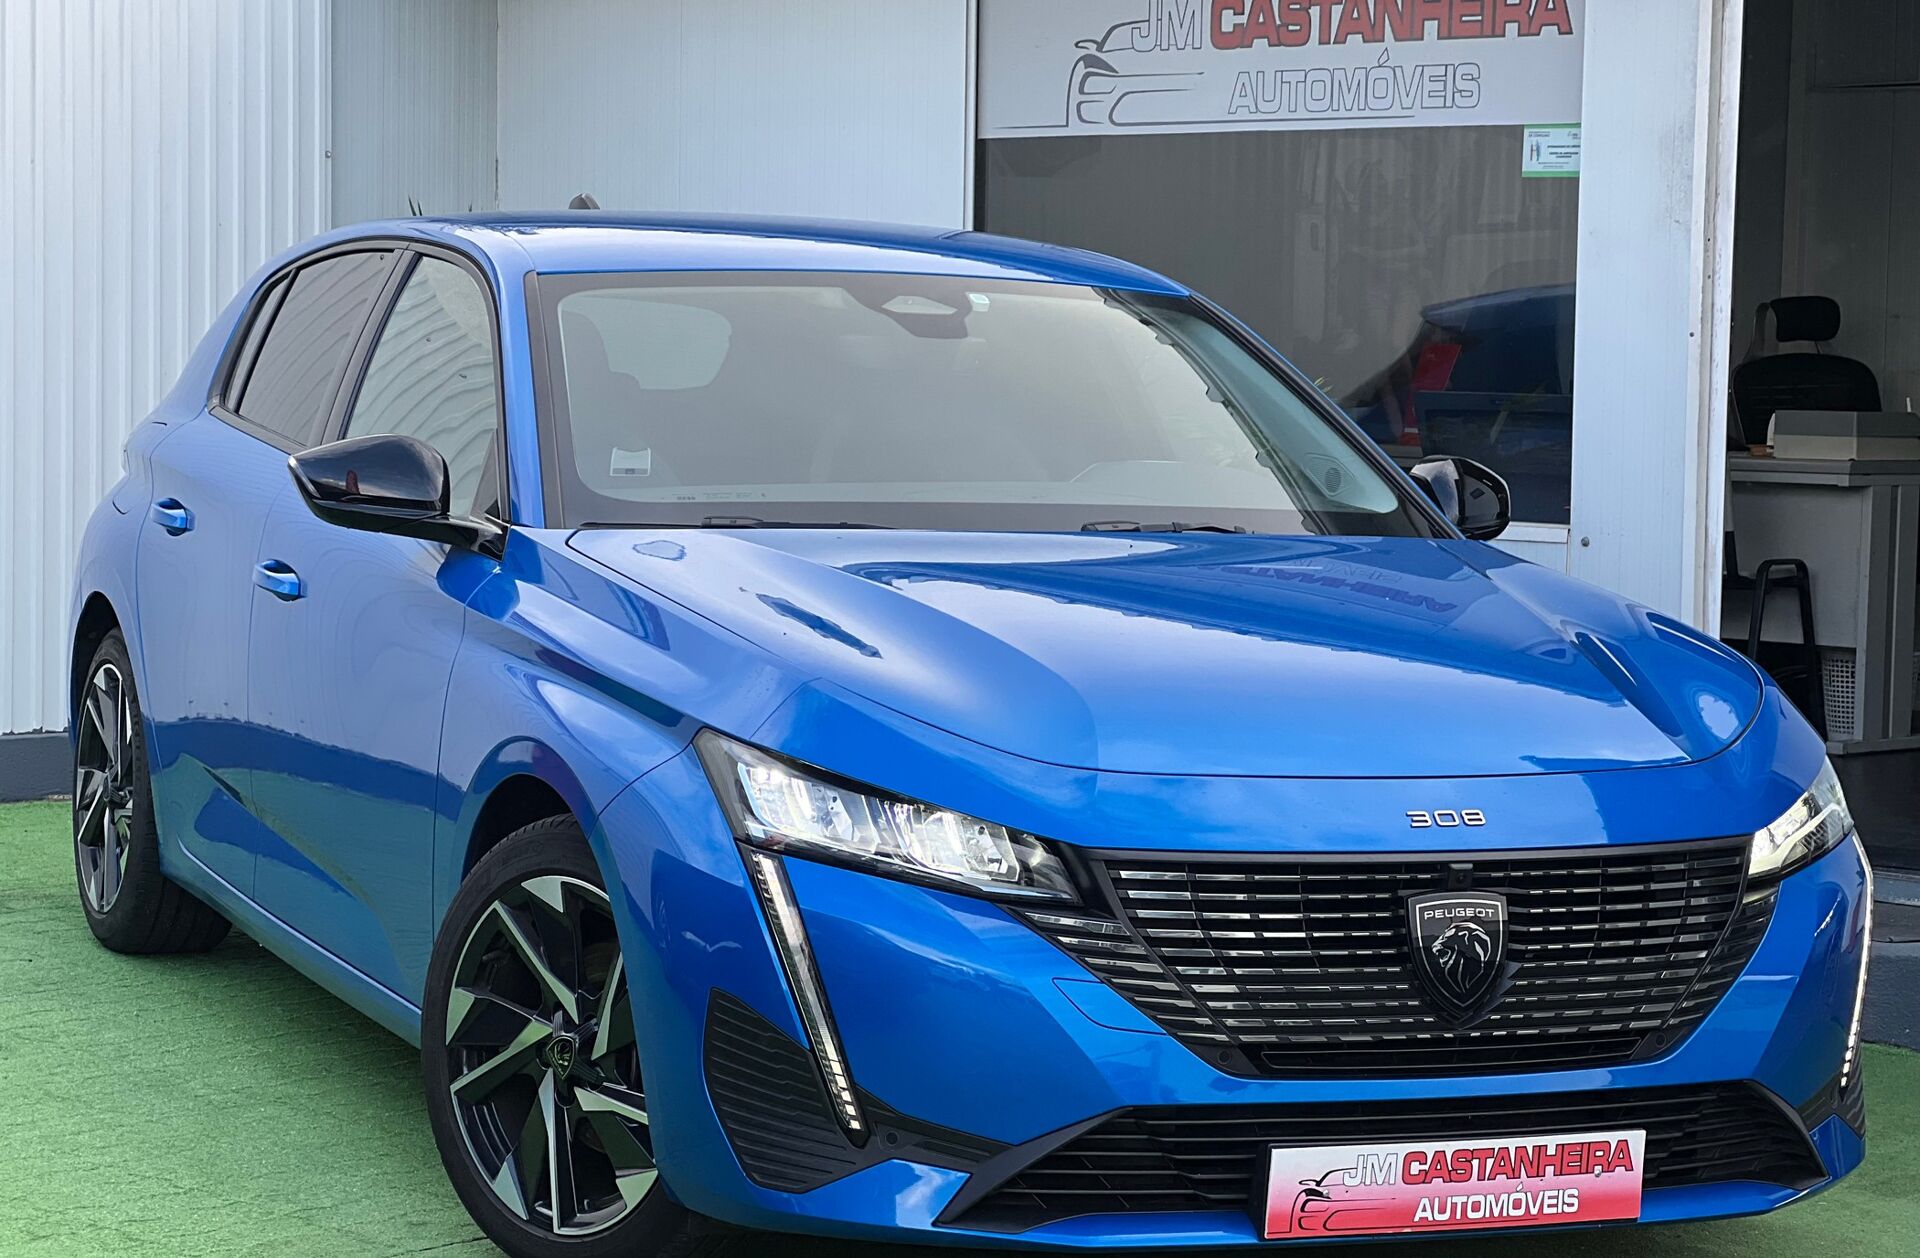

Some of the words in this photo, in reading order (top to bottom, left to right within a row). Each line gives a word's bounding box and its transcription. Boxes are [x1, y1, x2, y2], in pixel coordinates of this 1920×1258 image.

[1130, 0, 1202, 52] JM
[1209, 0, 1574, 50] CASTANHEIRA
[1228, 47, 1480, 115] AUTOMÓVEIS
[1406, 809, 1486, 828] 308
[1424, 908, 1495, 920] PEUGEOT
[1342, 1152, 1399, 1188] JM
[1401, 1139, 1634, 1186] CASTANHEIRA
[1413, 1182, 1579, 1223] AUTOMÓVEIS
